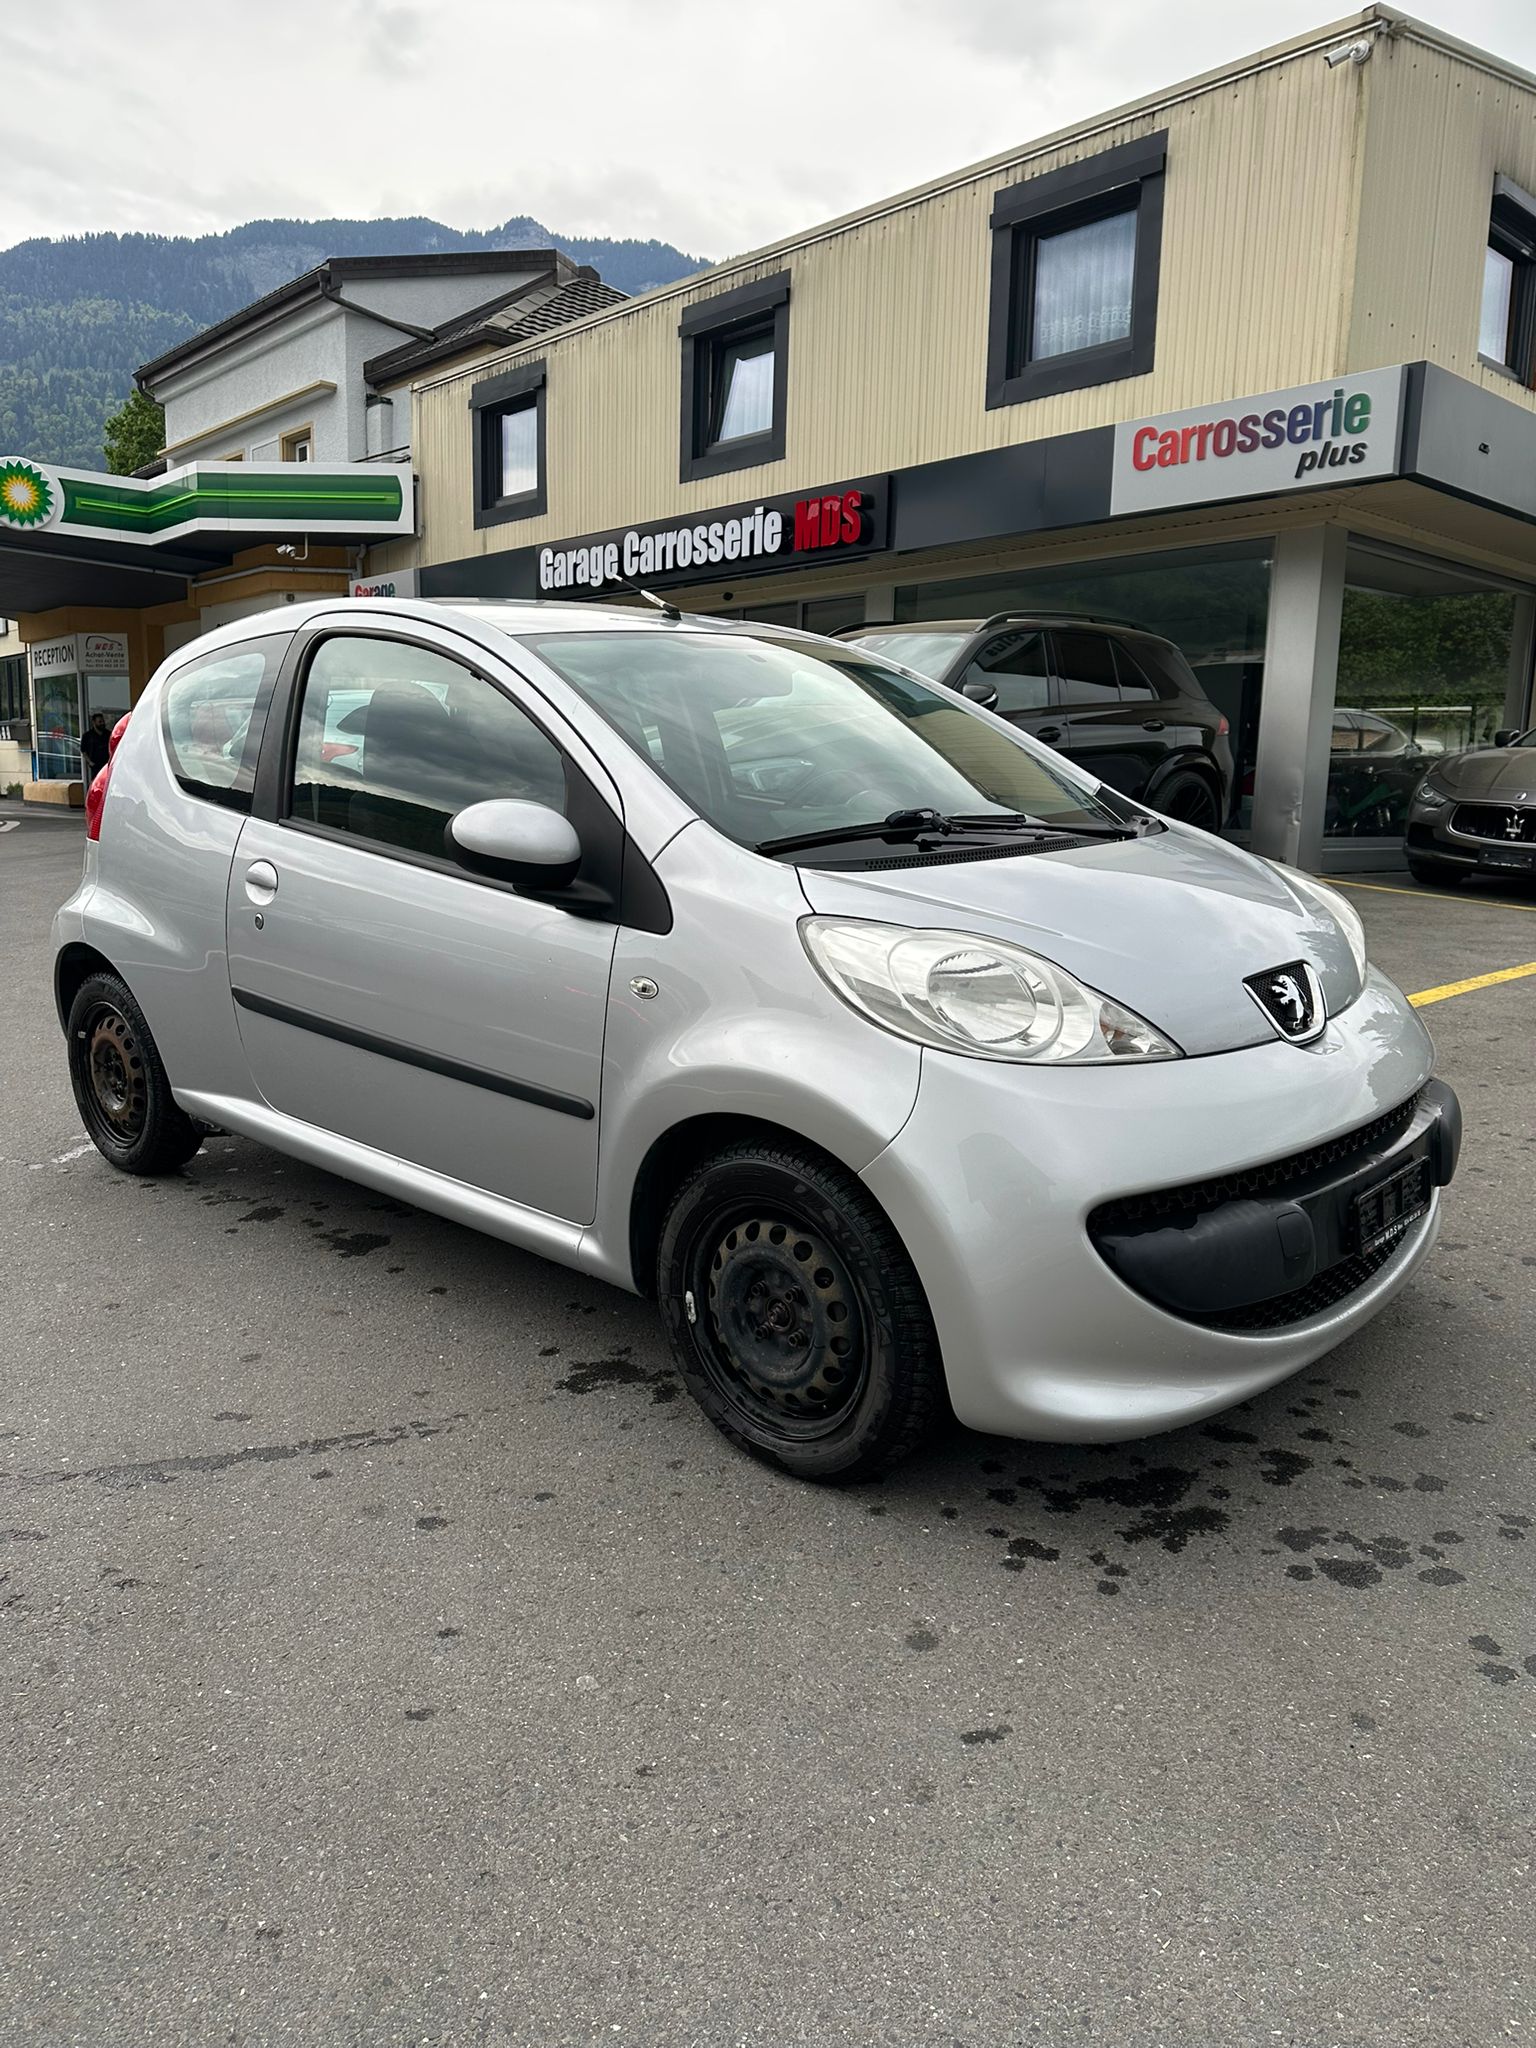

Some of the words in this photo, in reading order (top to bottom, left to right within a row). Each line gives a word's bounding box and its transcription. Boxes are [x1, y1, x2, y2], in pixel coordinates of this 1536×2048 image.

[1132, 388, 1372, 472] Carrosserie
[1294, 440, 1368, 479] plus
[539, 543, 619, 590] Garage
[623, 505, 783, 577] Carrosserie
[794, 490, 862, 552] MDS
[355, 583, 396, 598] Garage
[34, 644, 75, 667] RECEPTION
